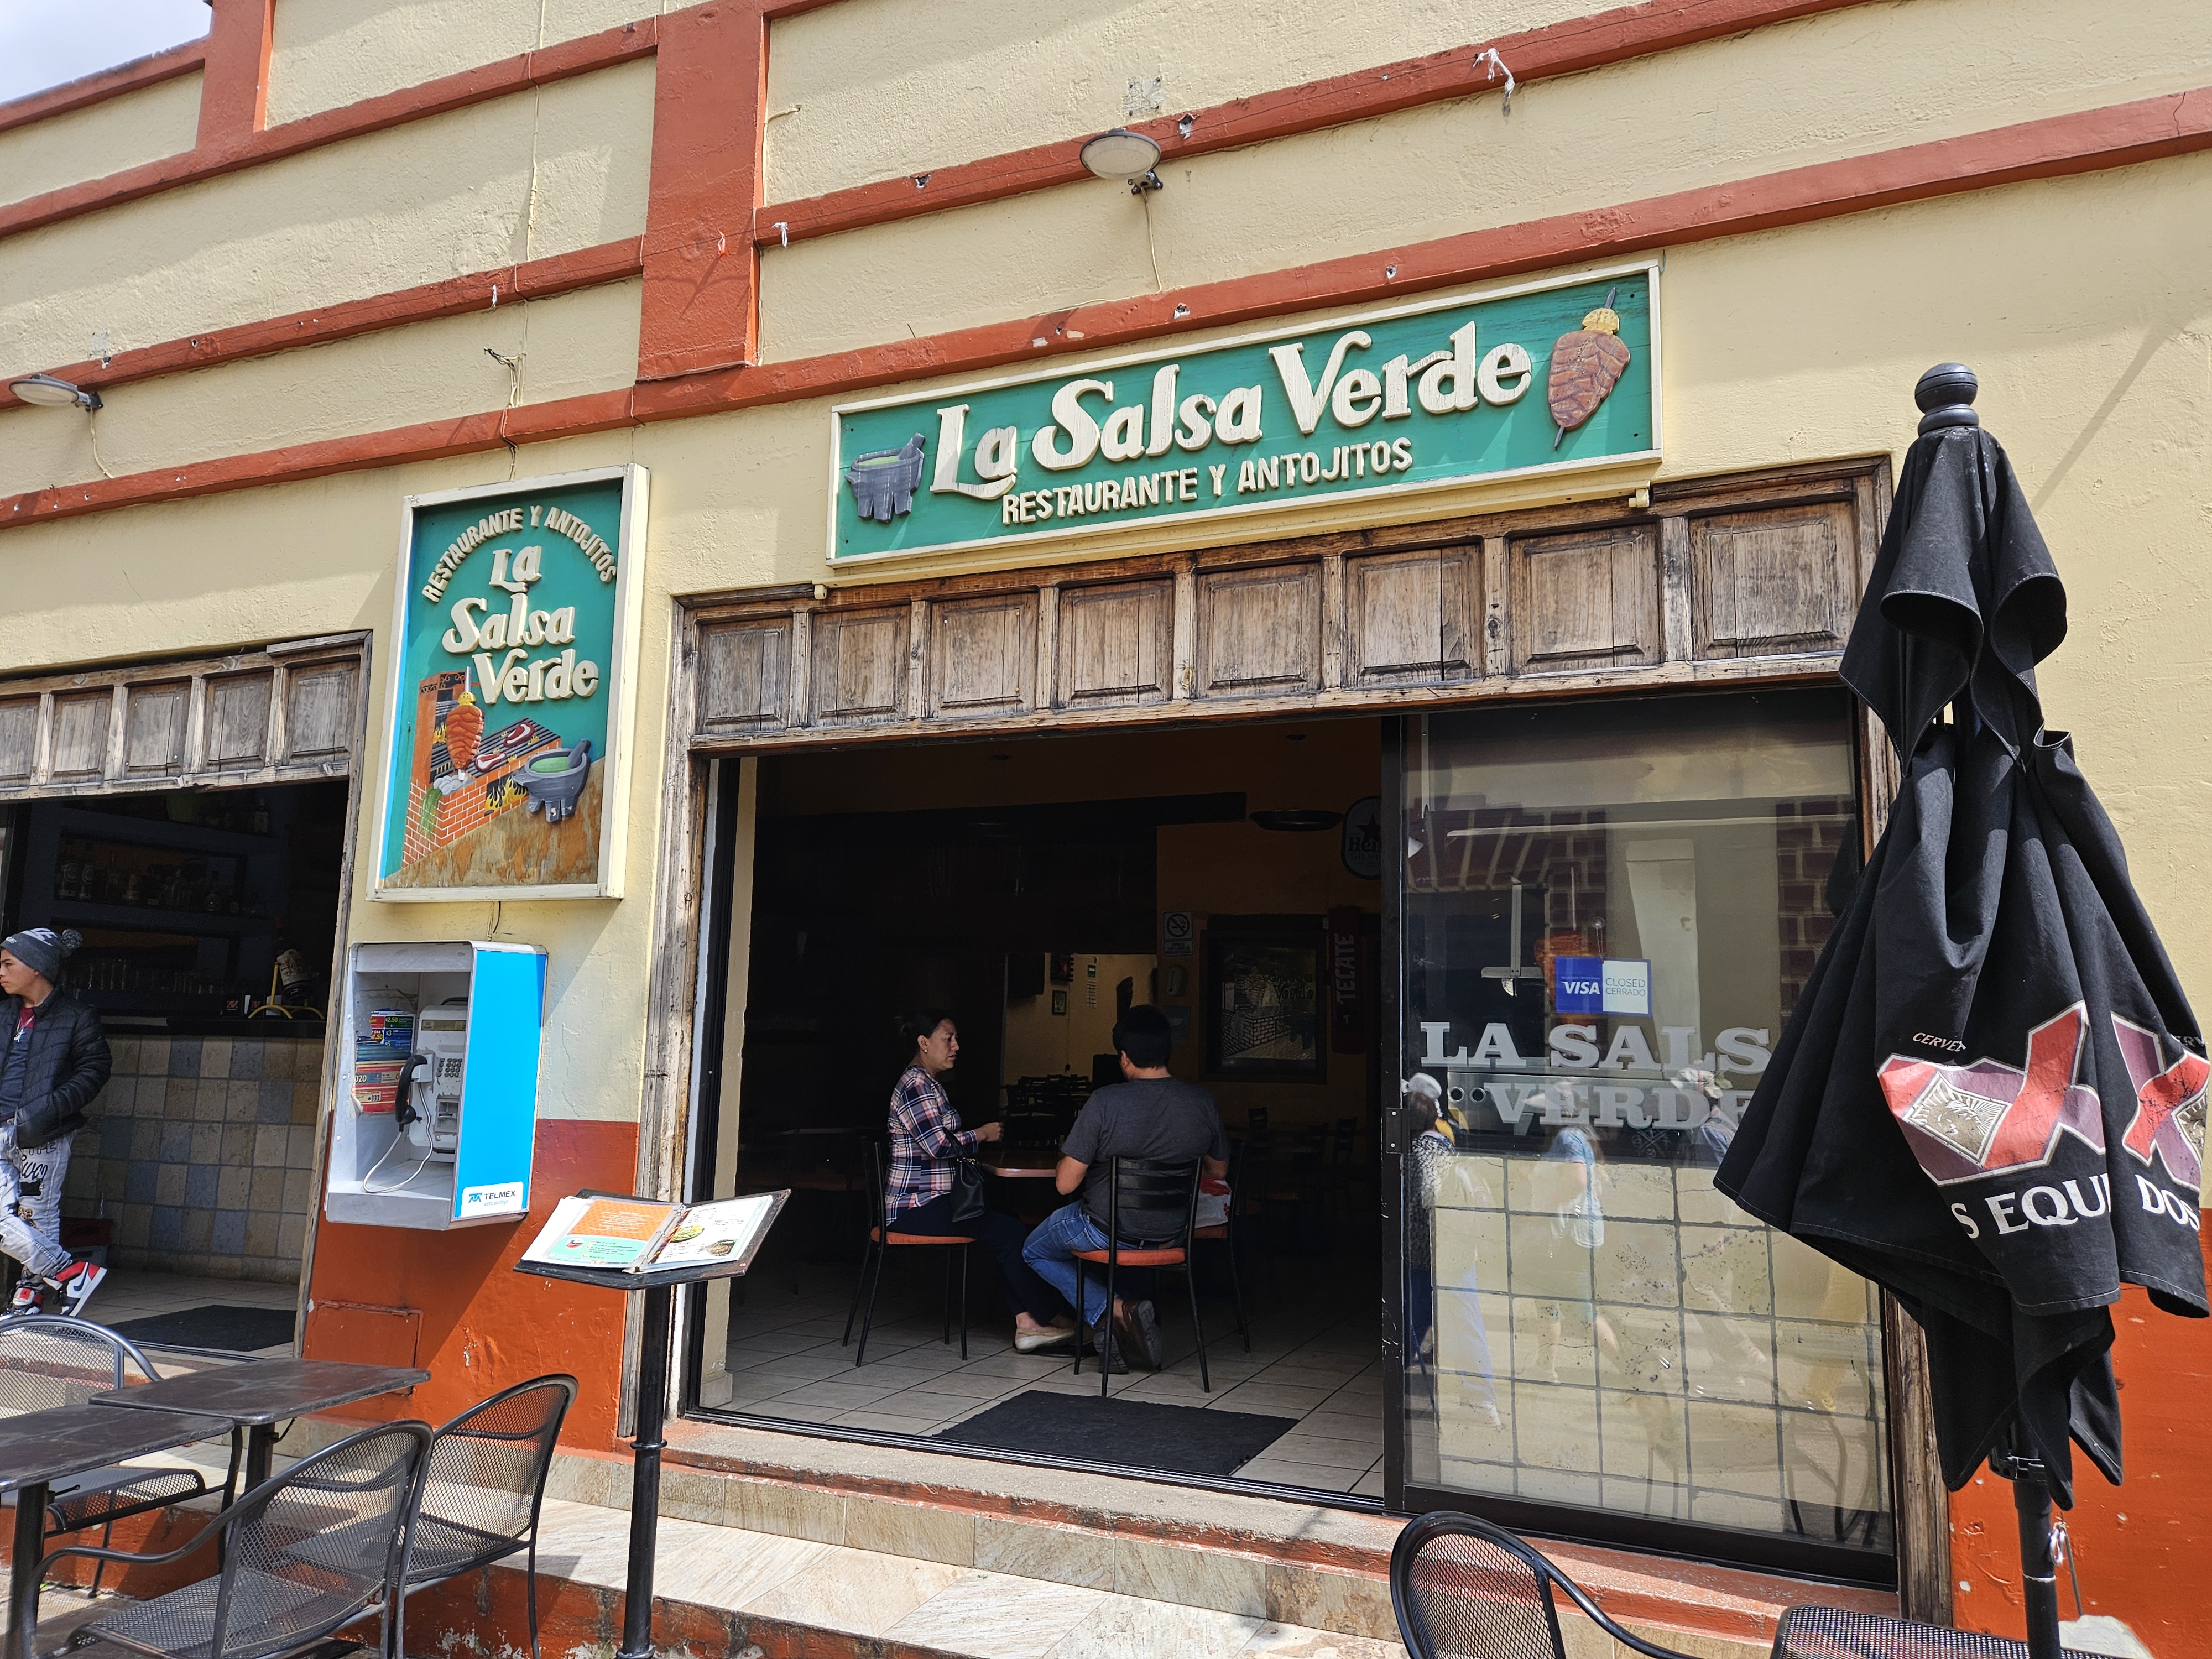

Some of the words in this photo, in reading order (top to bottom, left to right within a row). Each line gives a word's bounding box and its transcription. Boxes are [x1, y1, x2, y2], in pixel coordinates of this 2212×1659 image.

[930, 404, 1018, 500] La
[1031, 364, 1262, 471] Salsa
[1269, 320, 1532, 434] Verde
[1002, 467, 1198, 525] RESTAURANTE
[1208, 463, 1227, 497] Y
[1237, 437, 1413, 494] ANTOJITOS
[421, 507, 524, 603] RESTAURANTE
[530, 505, 544, 528] Y
[544, 506, 617, 583] ANTOJITOS
[489, 545, 542, 593] La
[442, 592, 576, 654] Salsa
[472, 648, 599, 705] Verde
[1333, 932, 1356, 1005] TECATE
[1561, 982, 1600, 994] VISA
[1605, 977, 1646, 988] CLOSED
[1605, 987, 1646, 997] CERRADO
[1420, 1022, 1526, 1067] LA
[1548, 1024, 1772, 1074] SALS
[484, 1190, 515, 1199] TELMEX
